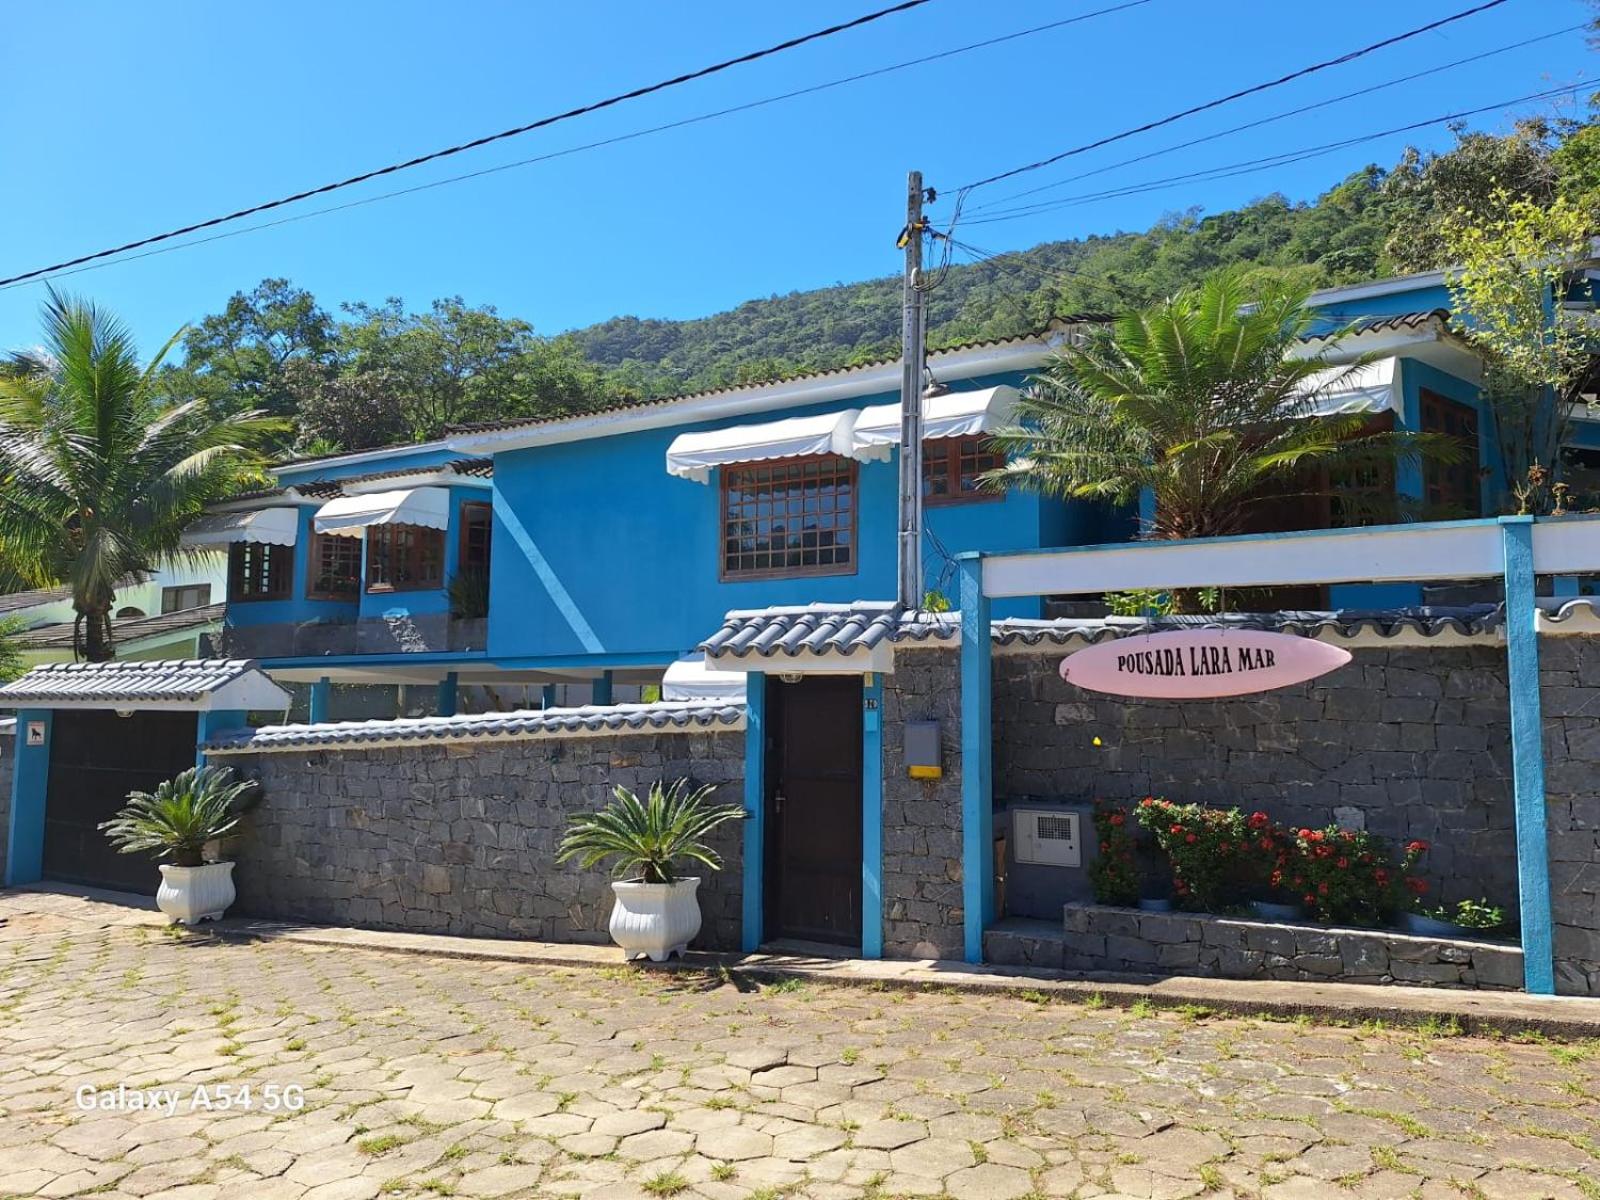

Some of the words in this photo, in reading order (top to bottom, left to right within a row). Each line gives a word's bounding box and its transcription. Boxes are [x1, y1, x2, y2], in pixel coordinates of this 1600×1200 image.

[1117, 647, 1186, 676] POUSADA
[1189, 646, 1233, 676] LARA
[1238, 647, 1276, 672] MAR
